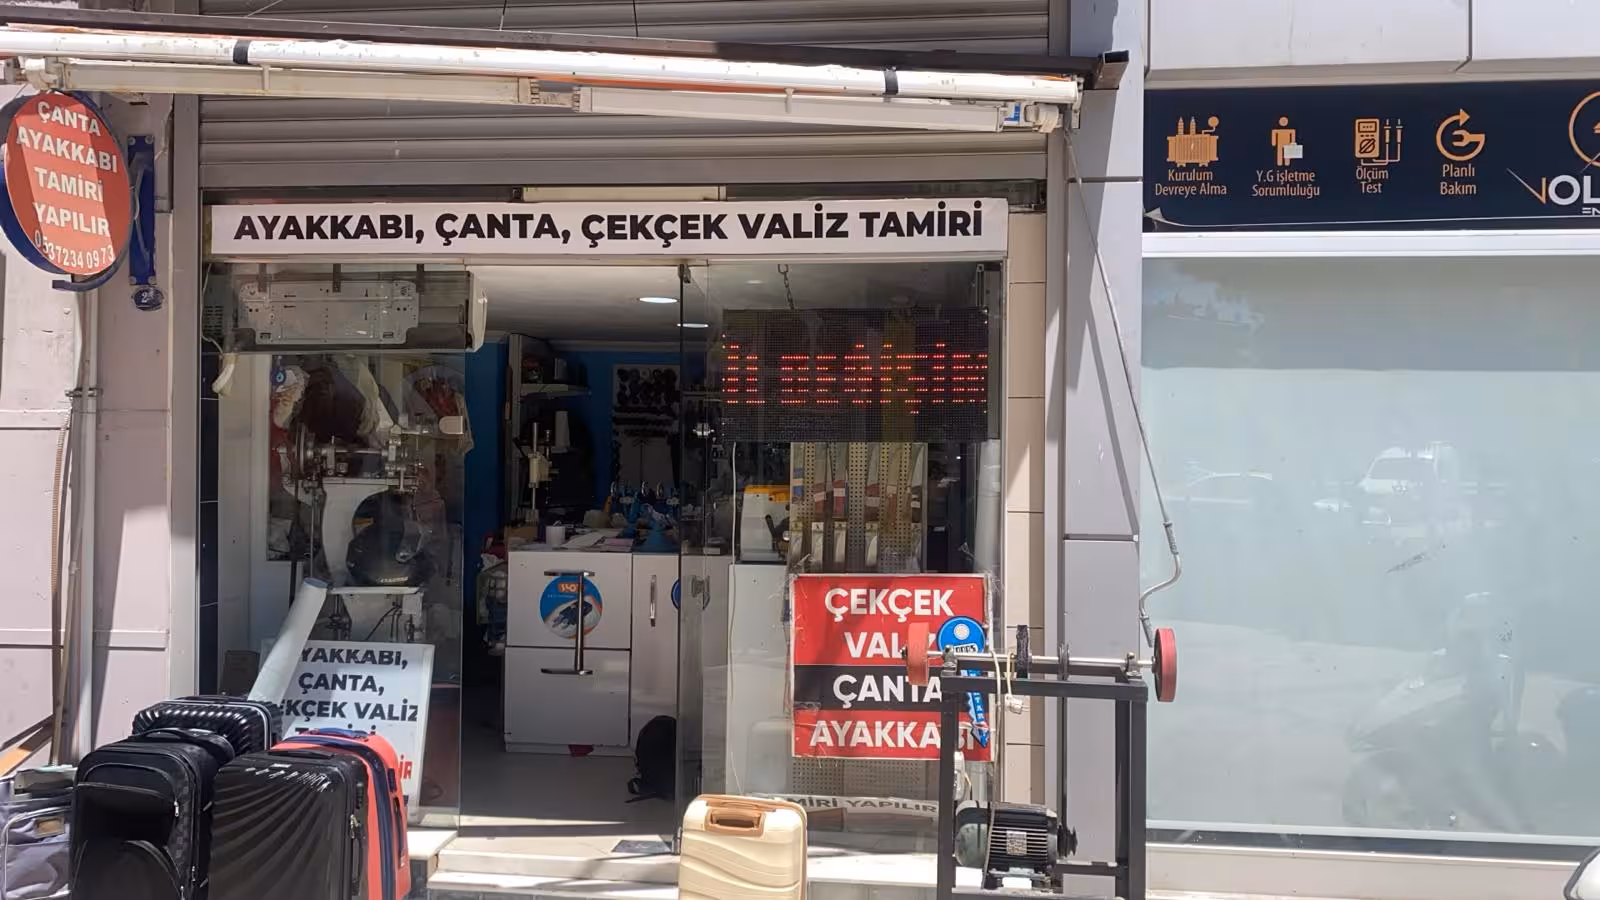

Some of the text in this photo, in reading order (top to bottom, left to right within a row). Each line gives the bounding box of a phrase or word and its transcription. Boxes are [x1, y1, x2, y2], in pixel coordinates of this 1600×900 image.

[37, 100, 101, 137] ÇANTA
[16, 126, 118, 174] AYAKKABI
[1168, 168, 1214, 182] Kurulum
[1276, 169, 1315, 185] işletme
[1355, 165, 1389, 182] Ölçüm
[1442, 163, 1475, 177] Planlı
[34, 166, 104, 203] TAMİRİ
[1155, 182, 1227, 198] Devreye Alma
[1252, 184, 1320, 199] Sorumluluğu
[1360, 181, 1382, 194] Test
[1440, 181, 1477, 196] Bakım
[33, 202, 111, 237] YAPILIR
[233, 200, 983, 249] AYAKKABI, ÇANTA, ÇEKÇEK VALİZ TAMİRİ
[824, 587, 955, 623] ÇEKÇEK
[300, 648, 409, 670] YAKKABI,
[298, 672, 385, 697] ÇANTA,
[354, 698, 419, 722] VALİZ
[845, 799, 938, 813] YAPILIR
